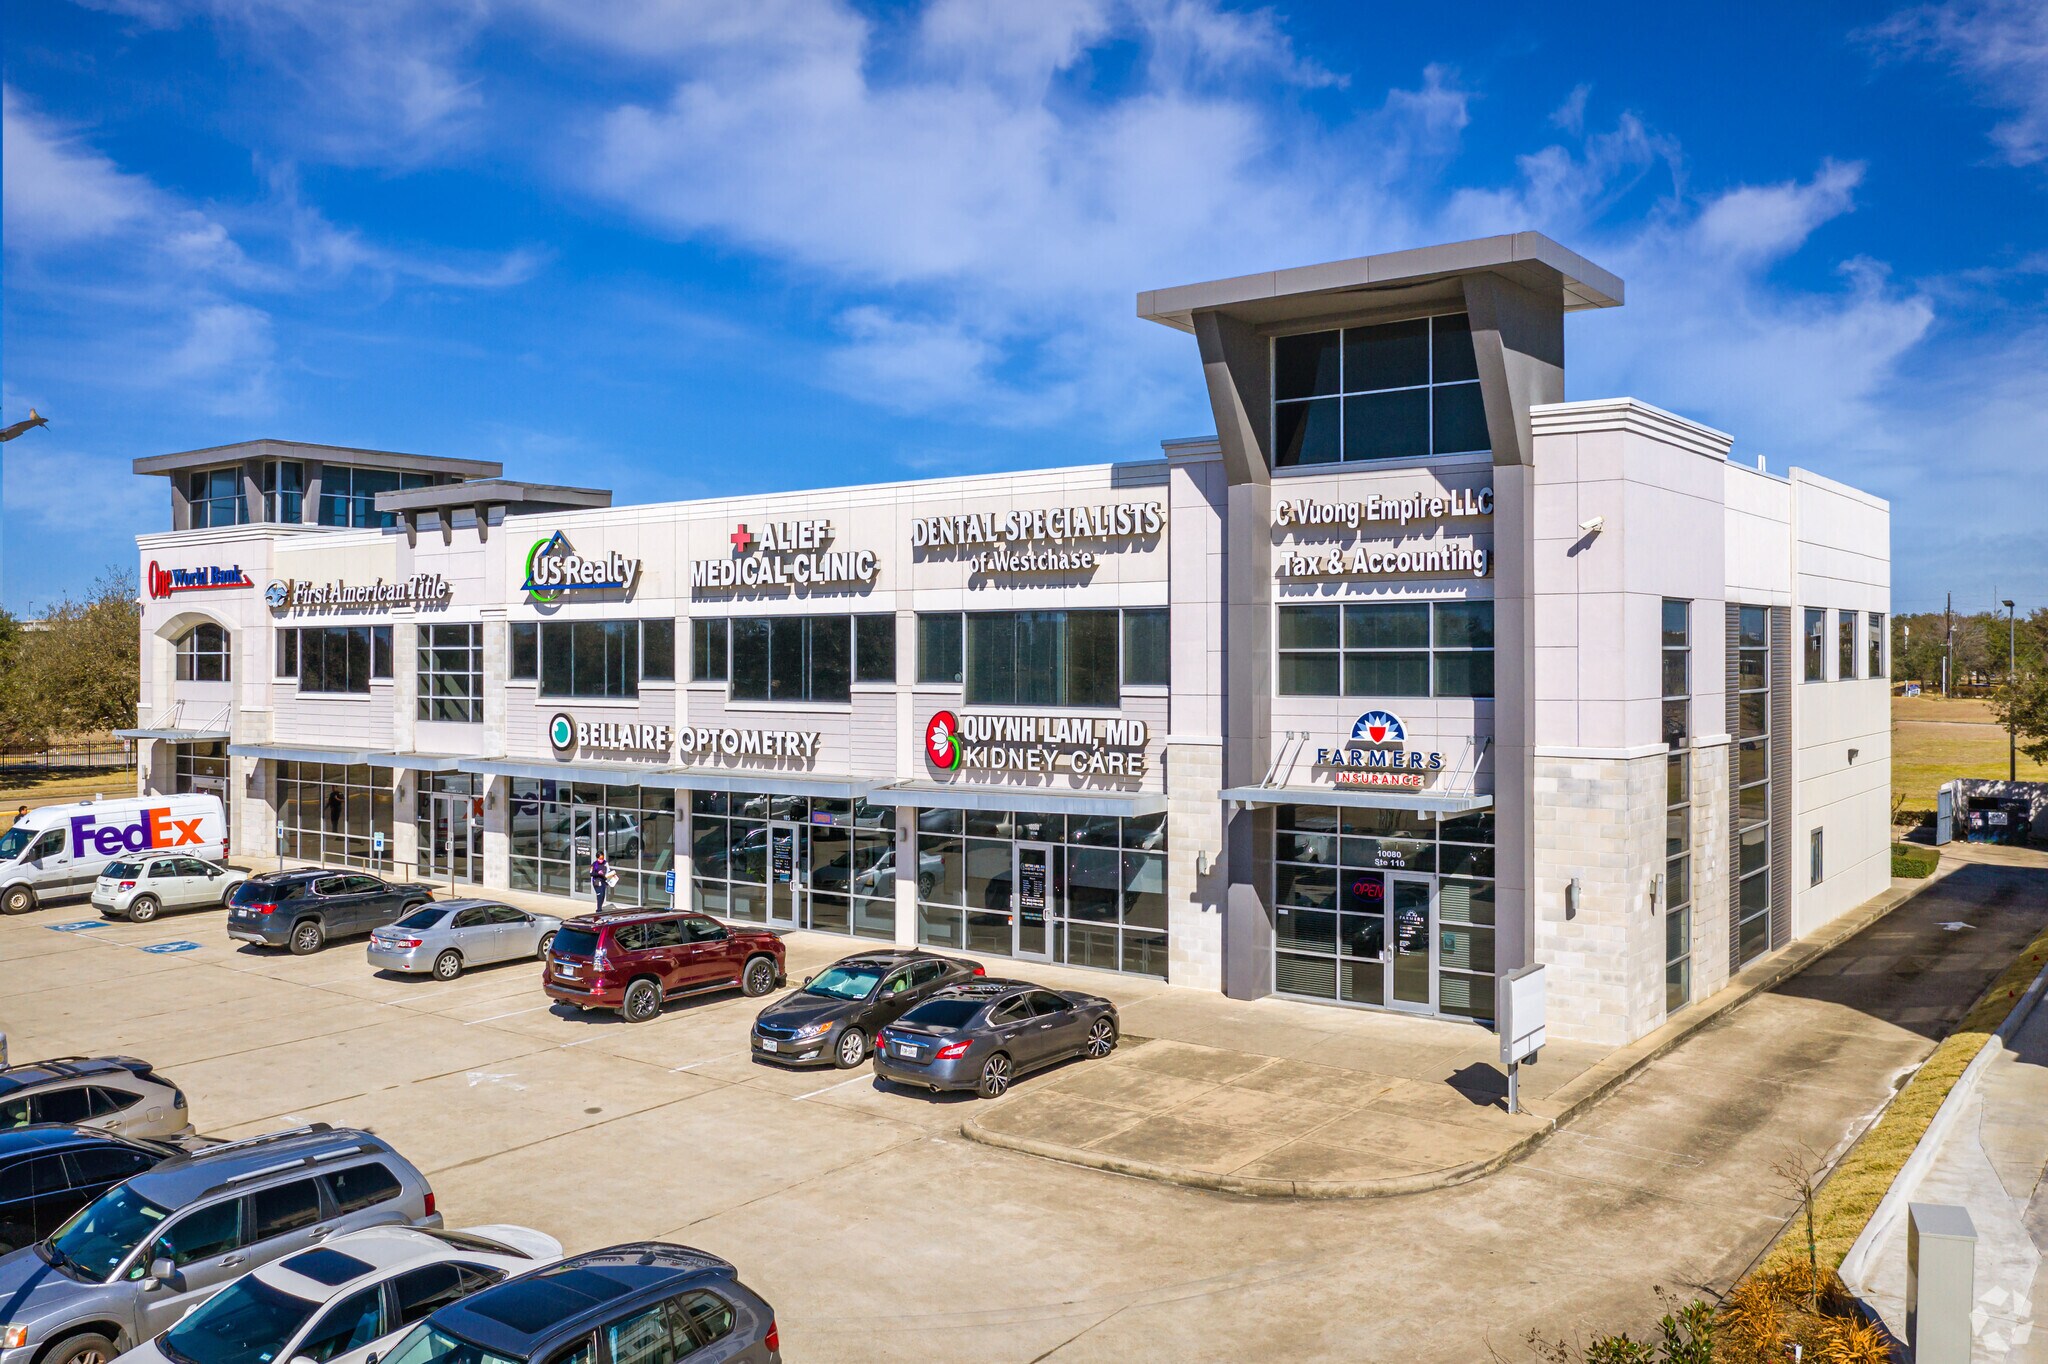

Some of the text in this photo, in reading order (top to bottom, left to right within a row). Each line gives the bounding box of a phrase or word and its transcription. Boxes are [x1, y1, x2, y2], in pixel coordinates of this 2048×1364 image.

[911, 501, 1161, 547] DENTAL SPECIALISTS
[1276, 487, 1494, 528] C Vuong Empire LLC
[759, 519, 831, 551] ALIEF
[566, 551, 640, 588] Realty
[690, 550, 877, 587] MEDICAL CLINIC
[969, 548, 1093, 573] of Westchase
[1281, 543, 1488, 577] Tax & Accounting
[149, 560, 243, 600] One World Bank
[292, 574, 449, 606] First American Title
[577, 722, 819, 756] BELLAIRE OPTOMETRY
[963, 716, 1146, 750] QUYNH LAM, MD
[965, 746, 1143, 776] KIDNEY CARE
[1317, 748, 1443, 770] FARMERS
[1335, 773, 1421, 786] INSURANCE
[70, 807, 205, 858] FedEx
[1374, 858, 1388, 866] Ste
[1377, 850, 1401, 858] 10080
[1353, 883, 1384, 898] OPEN
